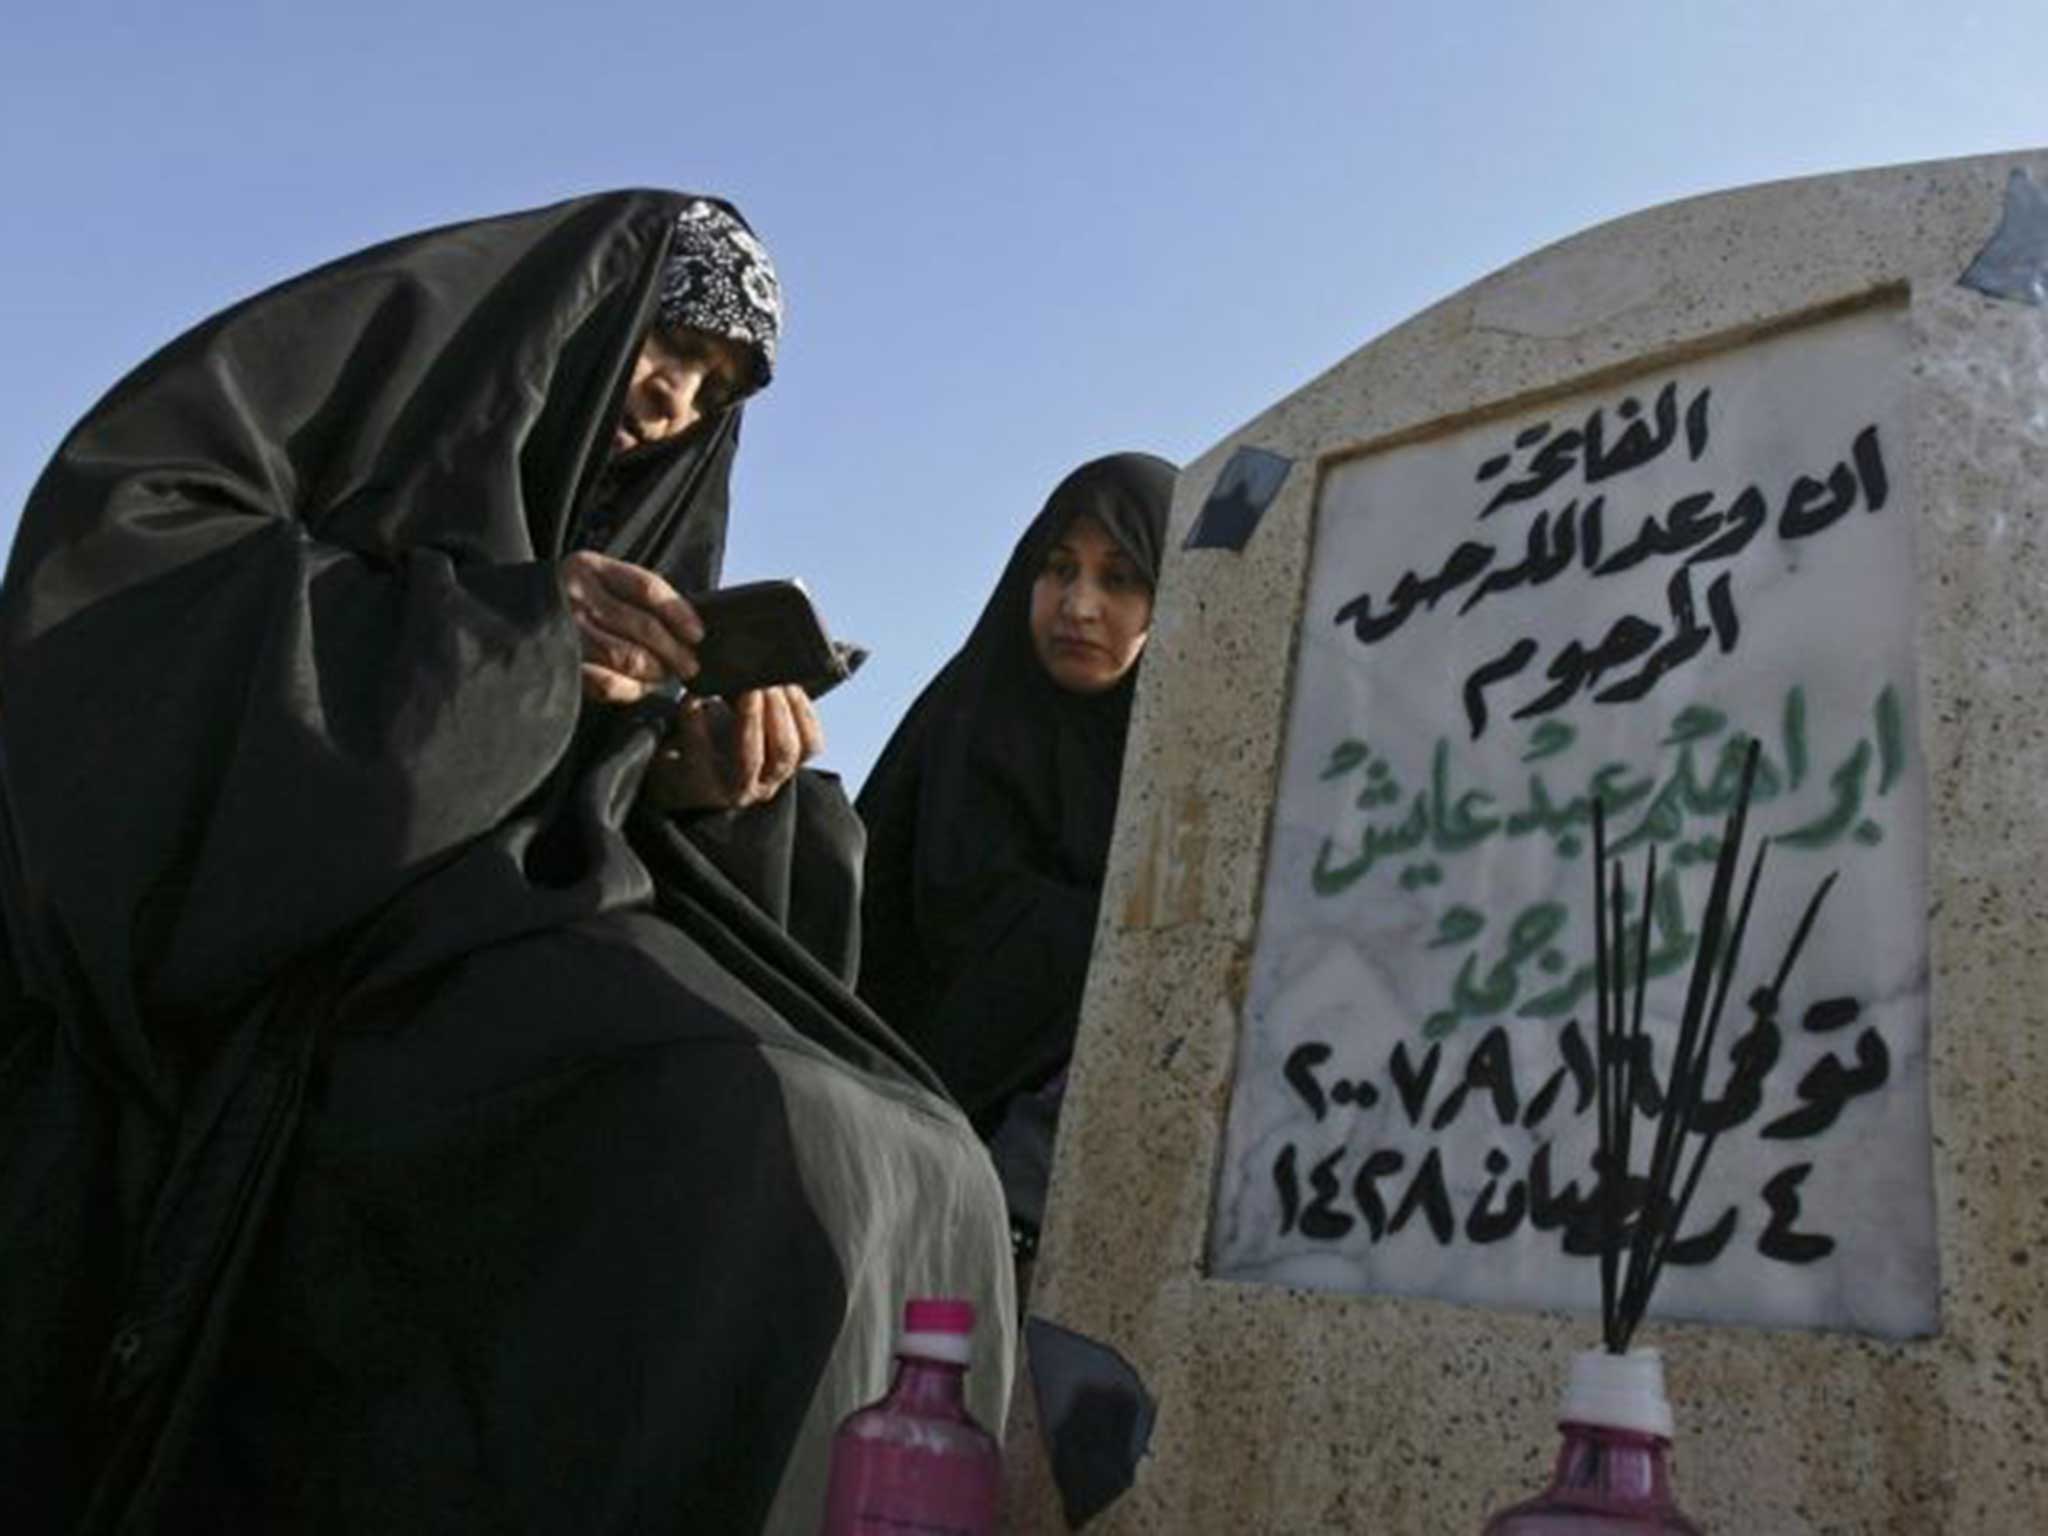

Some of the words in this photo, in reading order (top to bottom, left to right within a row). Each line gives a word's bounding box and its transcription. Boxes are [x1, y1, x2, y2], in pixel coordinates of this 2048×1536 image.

[1477, 381, 1710, 518] الفاتحة
[1778, 424, 1890, 540] ان
[1459, 495, 1605, 615] الله
[1593, 485, 1768, 578] وعد
[1334, 541, 1497, 643] حق
[1464, 564, 1740, 741] المرحوم
[1506, 719, 1655, 860] عبد
[1757, 1162, 1836, 1265] ٤
